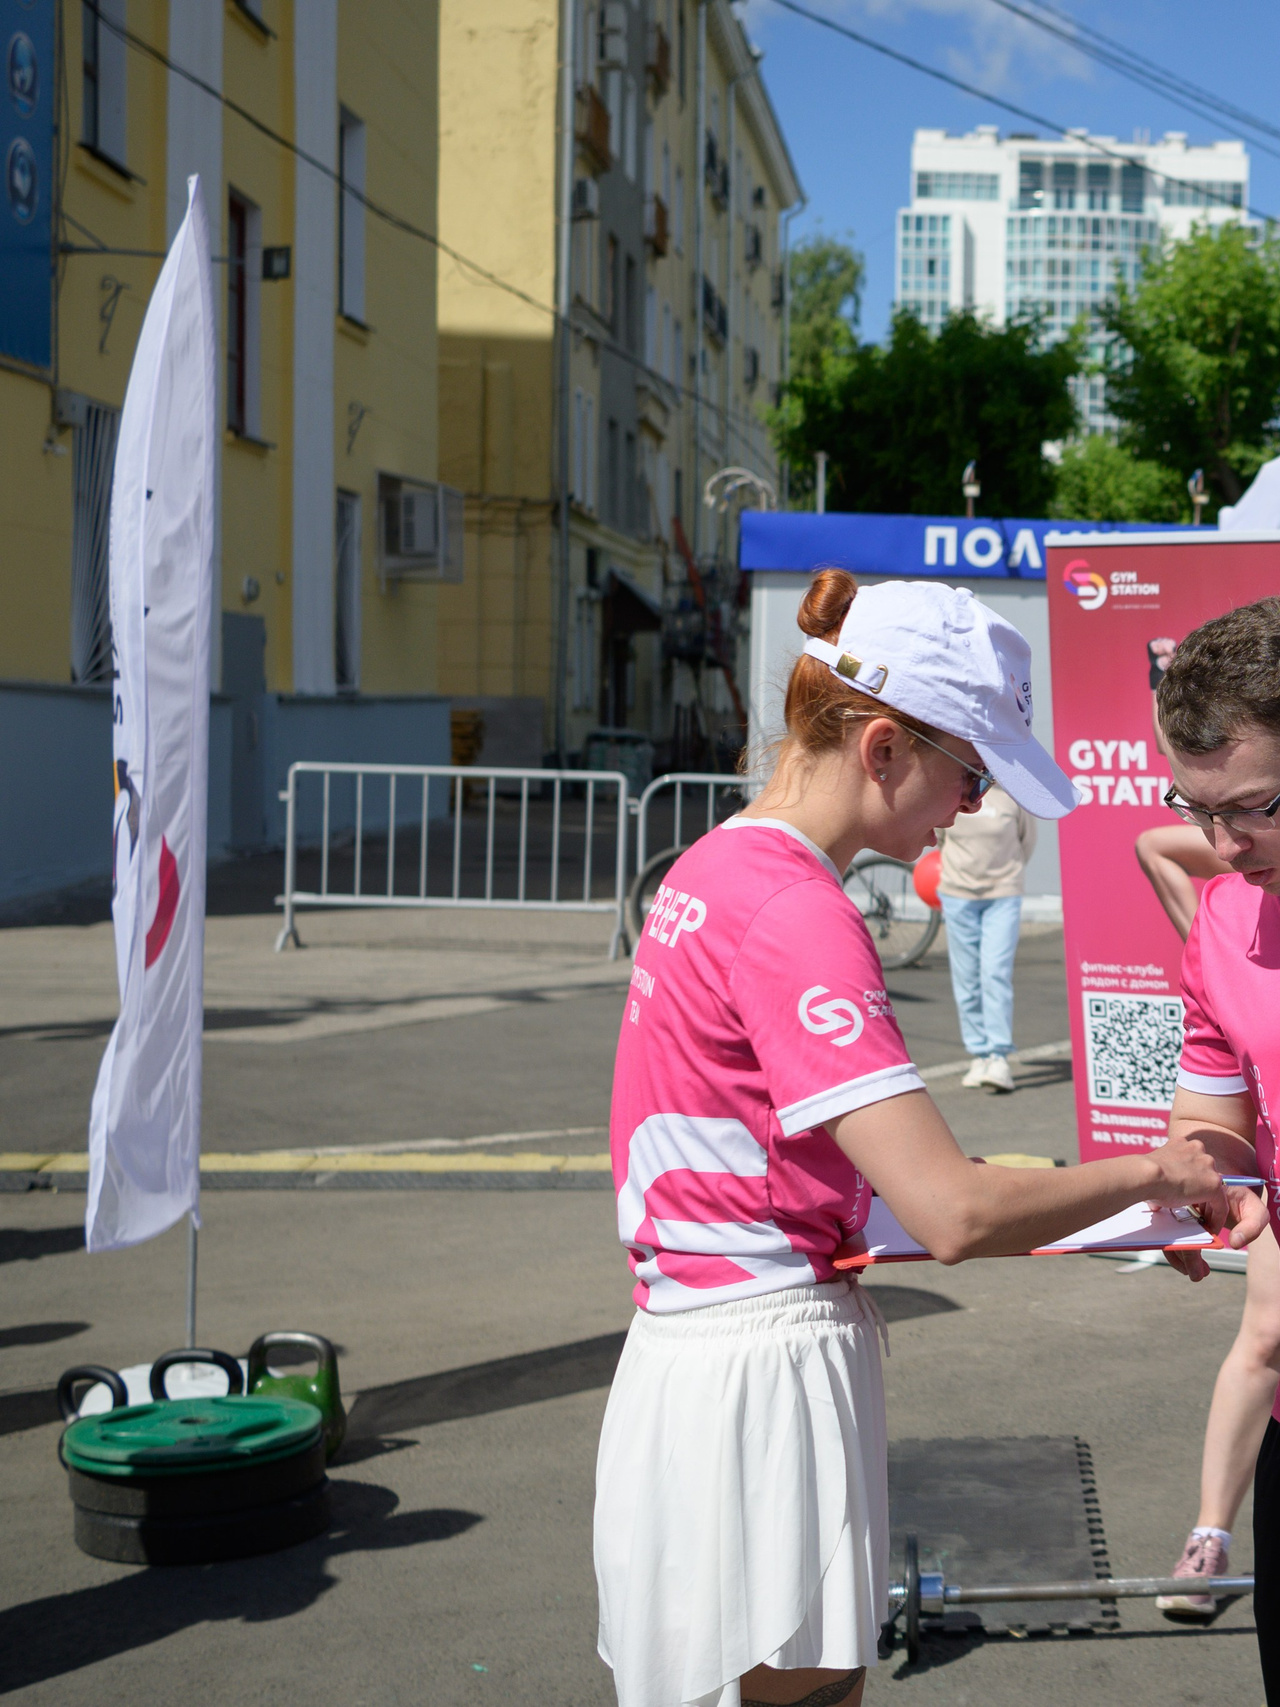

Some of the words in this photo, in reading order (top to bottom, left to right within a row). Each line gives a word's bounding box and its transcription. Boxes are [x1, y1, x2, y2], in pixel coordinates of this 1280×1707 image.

[924, 525, 1080, 568] ПОЛ
[1110, 572, 1137, 583] GYM
[1111, 584, 1160, 596] STATION
[1069, 739, 1148, 770] GYM
[1072, 775, 1170, 807] STATI
[648, 884, 707, 948] РЕНЕР
[1081, 961, 1164, 977] фитнес-клубы
[1081, 976, 1119, 988] рядом
[1120, 979, 1128, 988] с
[1130, 979, 1169, 990] домом
[1090, 1109, 1167, 1130] Запишись
[1092, 1130, 1112, 1143] на
